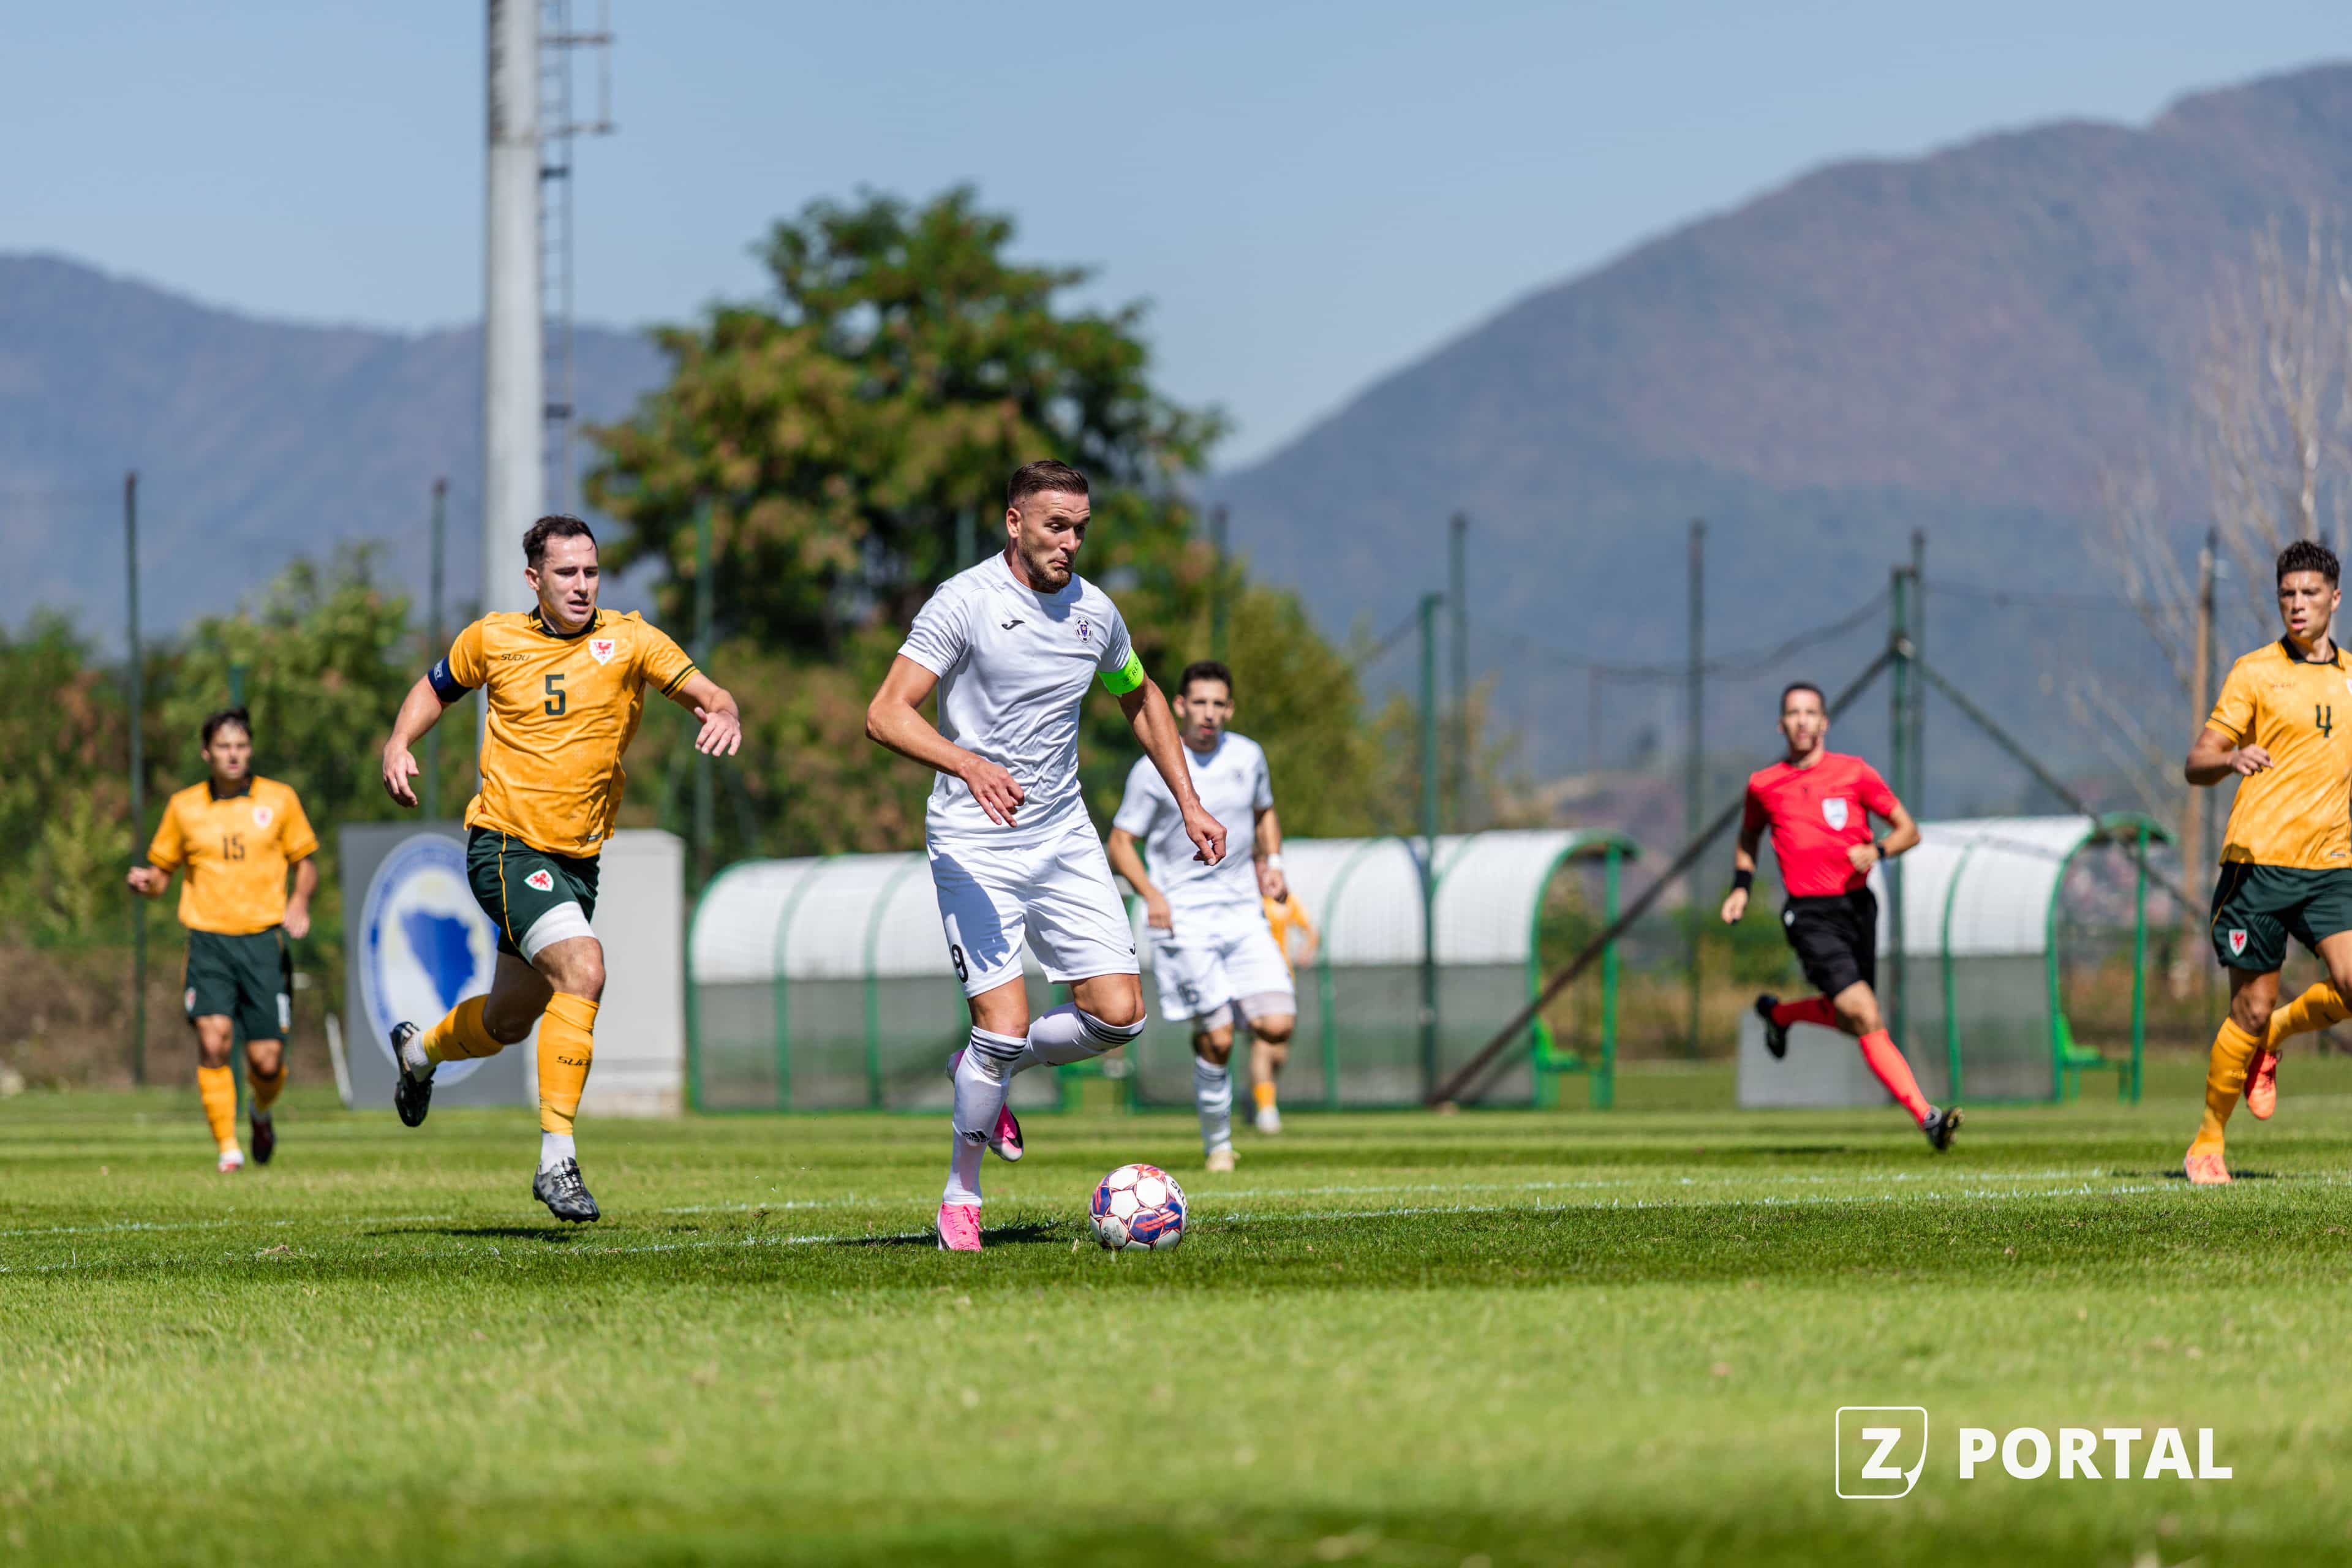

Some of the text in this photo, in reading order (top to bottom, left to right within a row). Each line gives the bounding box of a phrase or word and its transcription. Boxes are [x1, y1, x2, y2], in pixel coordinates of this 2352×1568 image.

[545, 674, 566, 715] 5
[2315, 704, 2332, 738] 4
[223, 835, 246, 861] 15
[951, 944, 968, 983] 9
[557, 1055, 592, 1066] SUD
